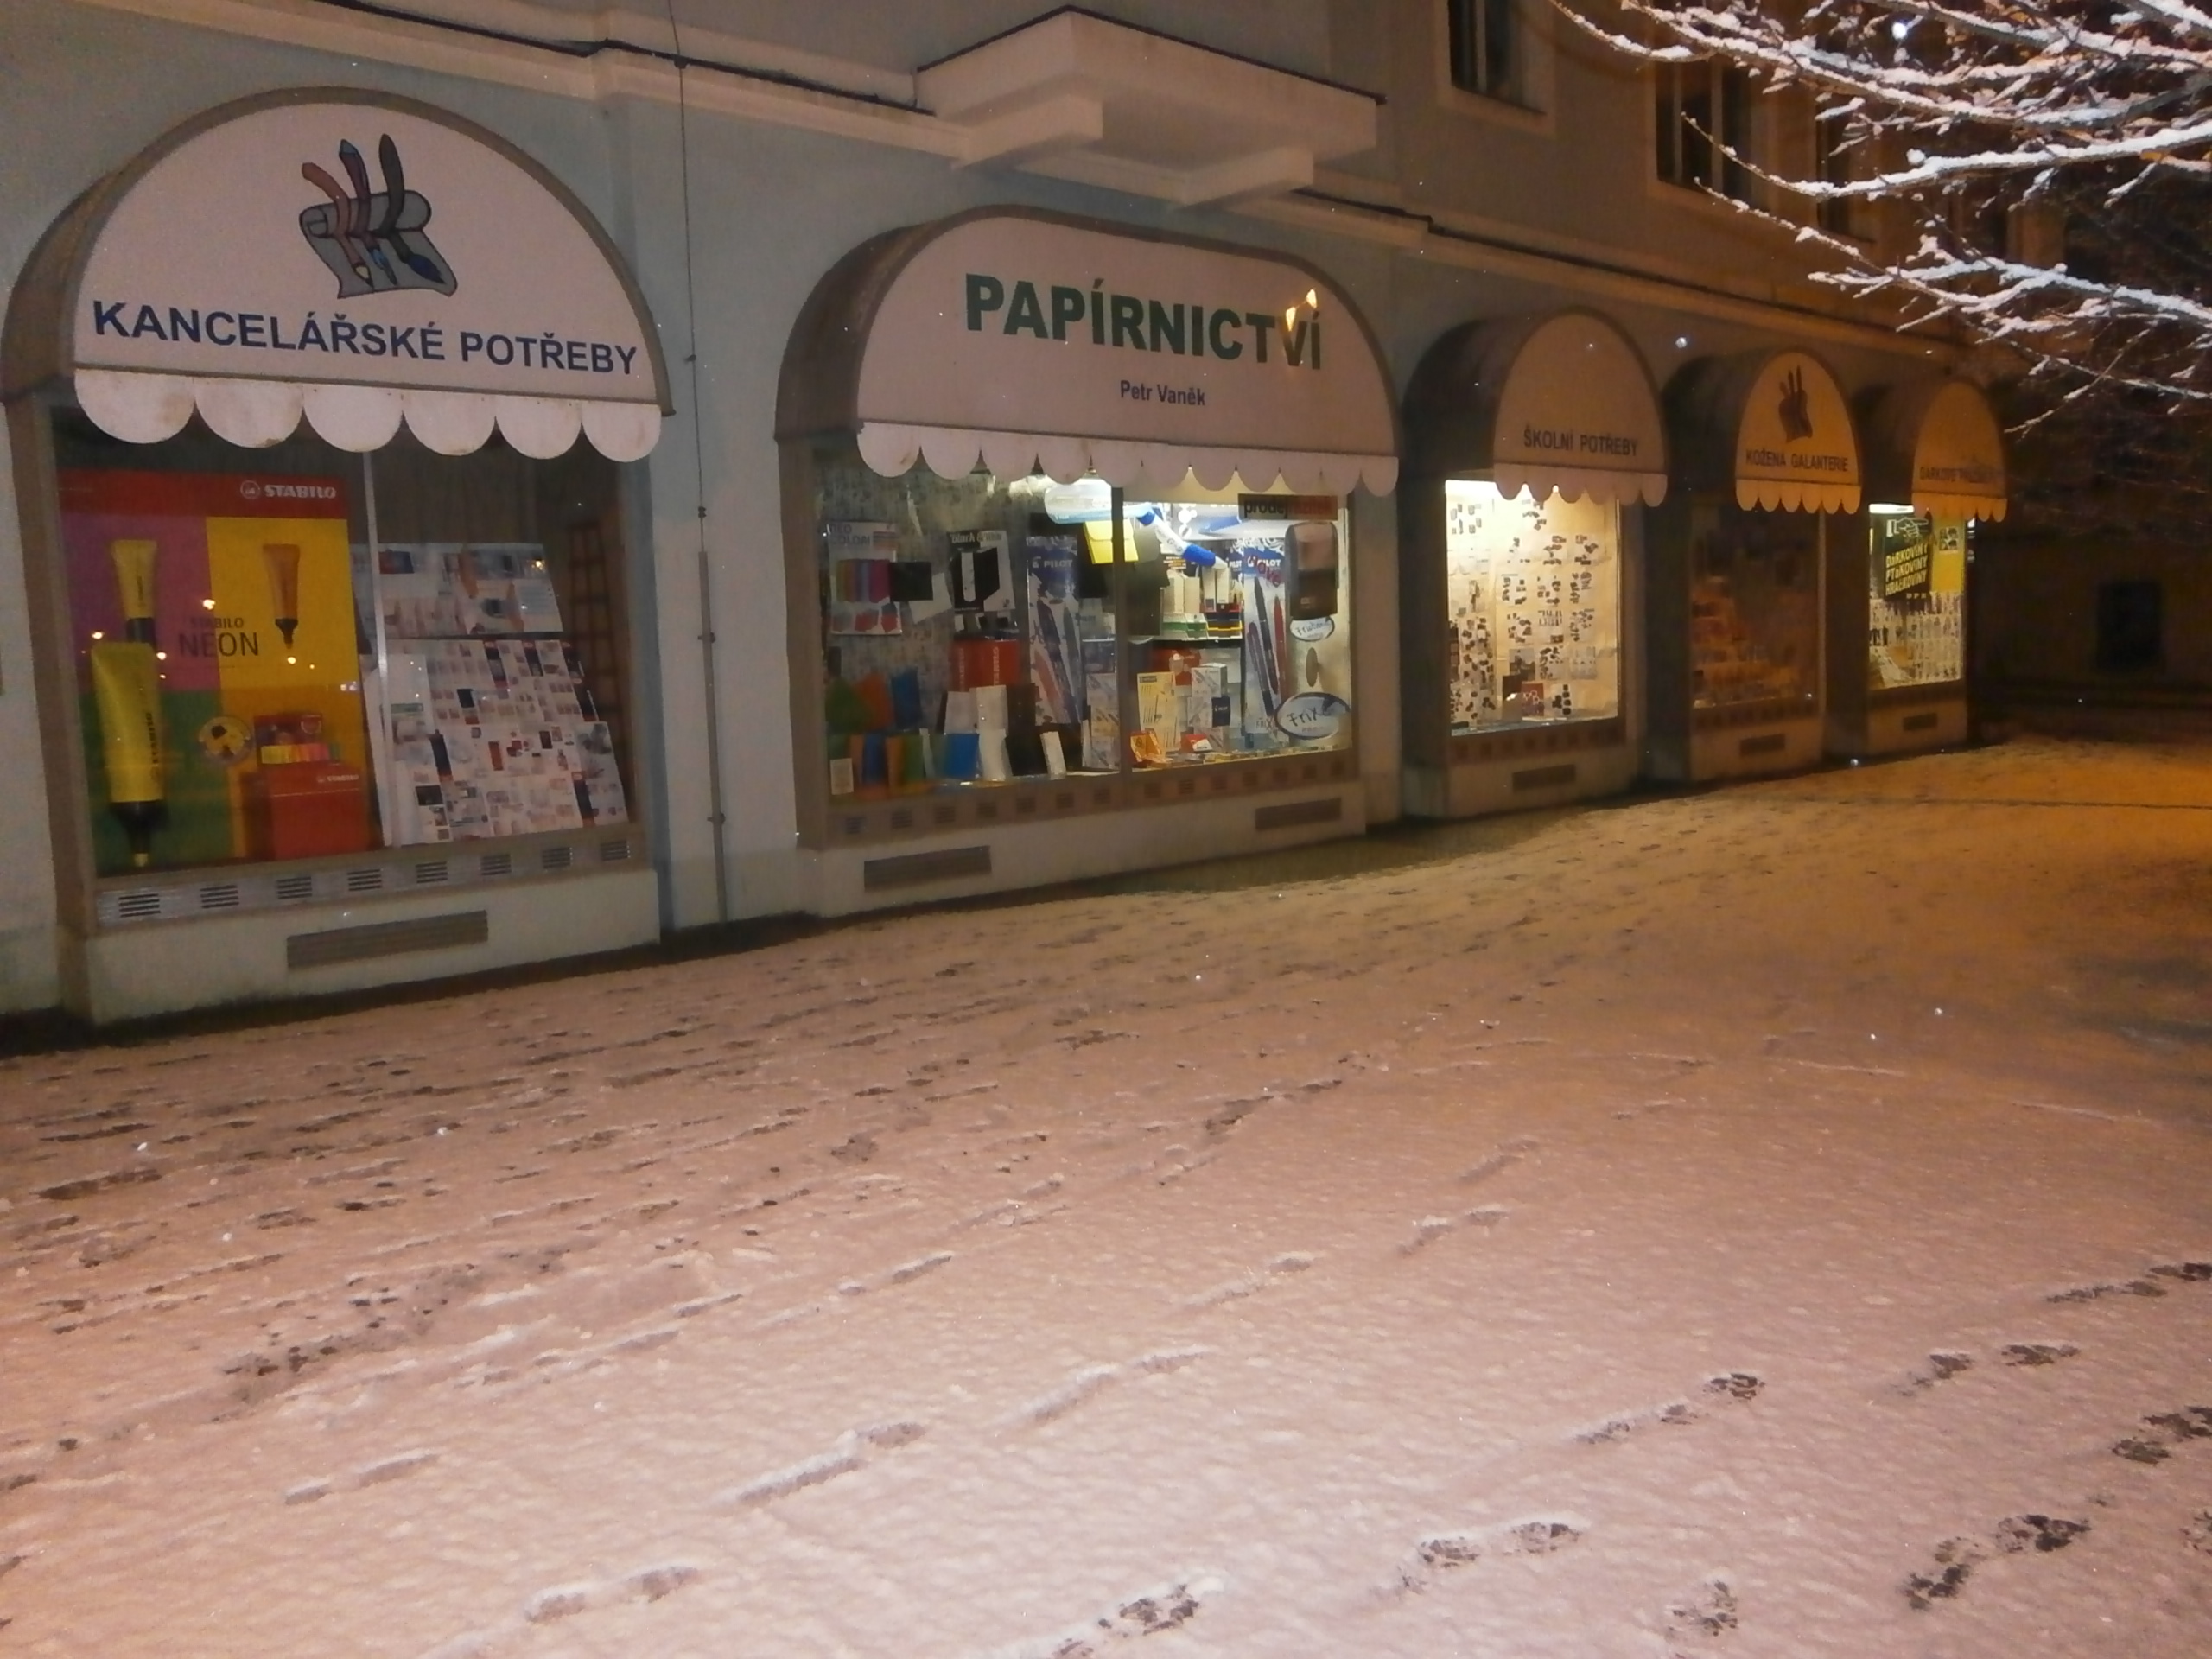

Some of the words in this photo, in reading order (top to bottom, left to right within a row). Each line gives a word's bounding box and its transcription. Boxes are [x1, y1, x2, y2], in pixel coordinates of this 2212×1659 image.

[966, 273, 1321, 370] PAPÍRNICTVÍ
[93, 300, 445, 360] KANCELÁŘSKÉ
[461, 331, 638, 374] POTŘEBY
[1121, 380, 1152, 403] Petr
[1156, 384, 1206, 406] Vaněk
[1523, 423, 1573, 450] ŠKOLNÍ
[1580, 434, 1638, 456] POTŘEBY
[1791, 454, 1848, 472] GALANTERIE
[264, 484, 336, 499] STABILO
[1044, 559, 1073, 568] PILOT
[189, 617, 244, 629] STABILO
[179, 632, 258, 656] NEON
